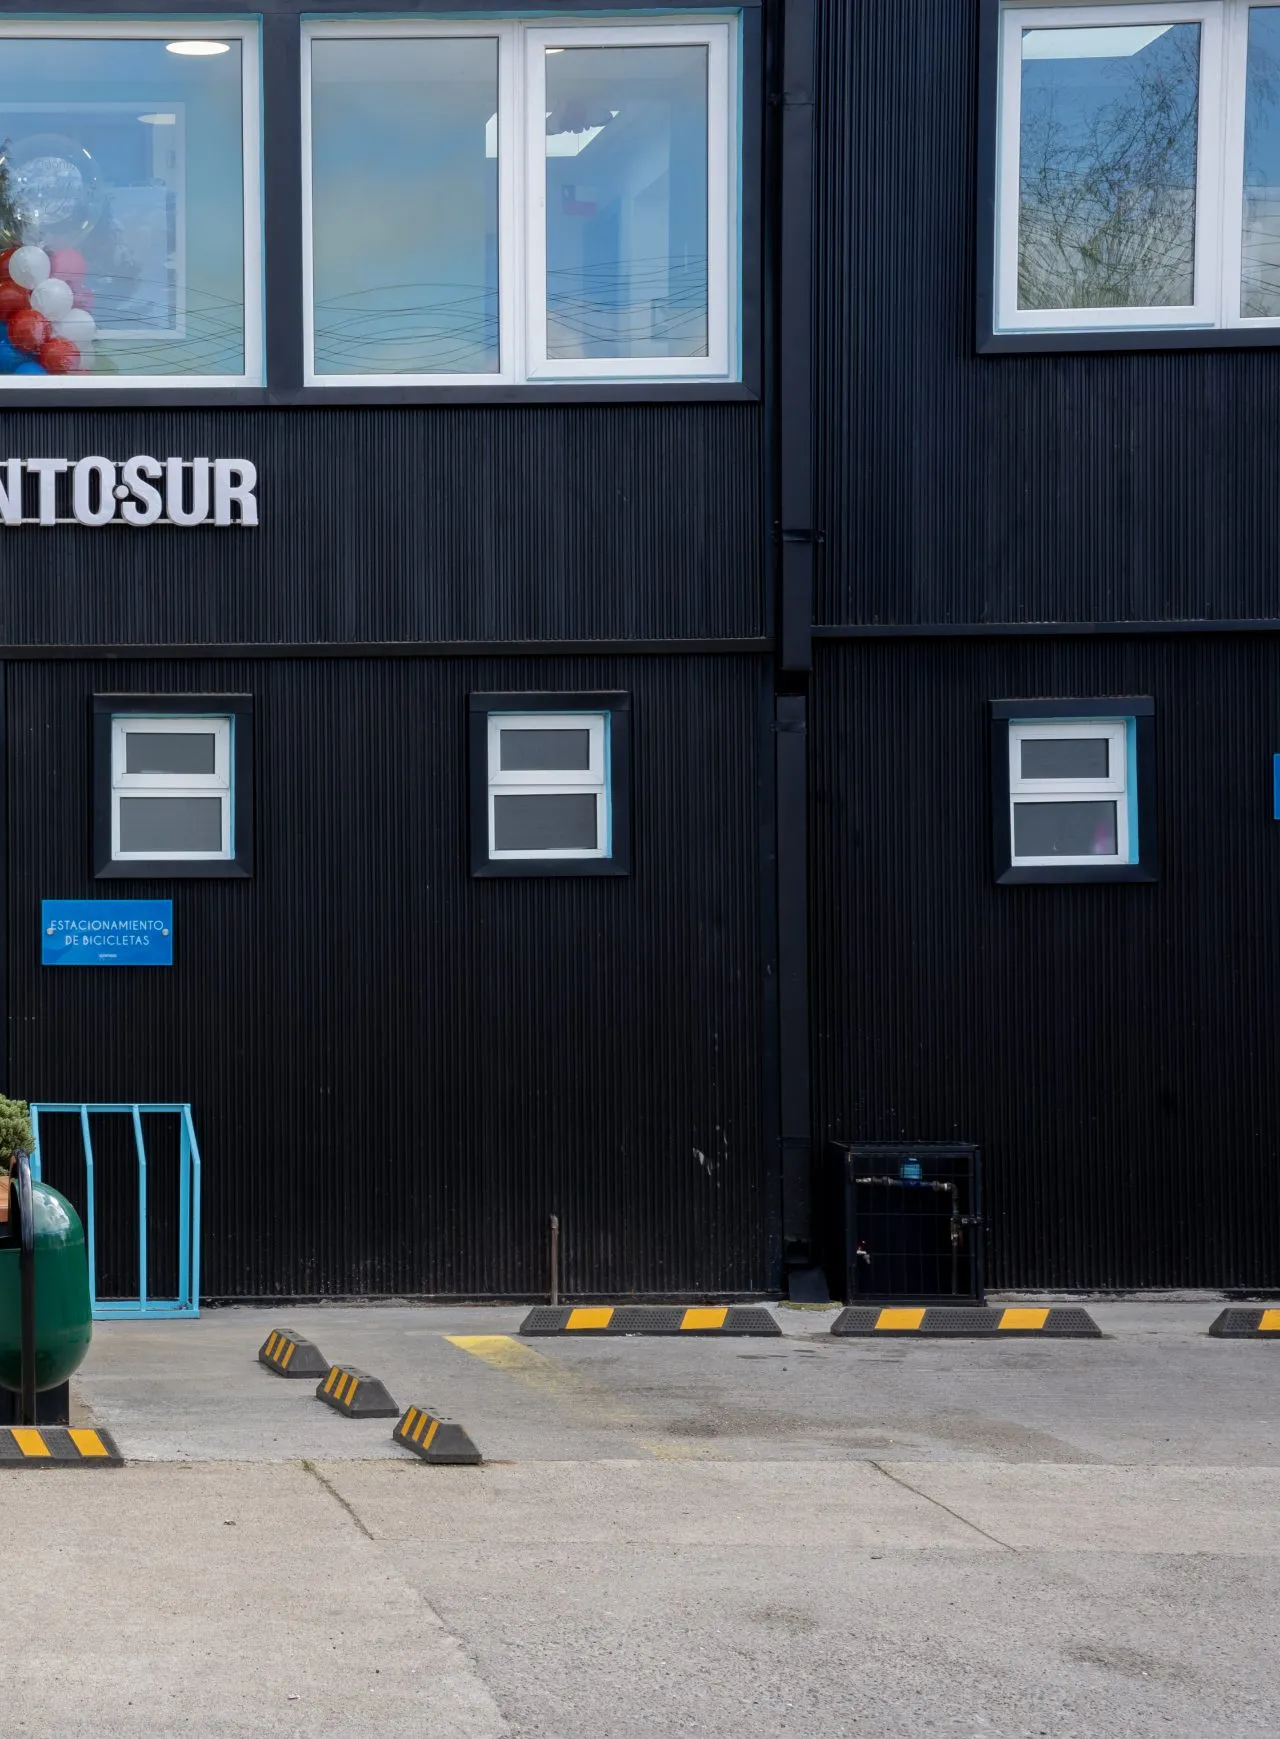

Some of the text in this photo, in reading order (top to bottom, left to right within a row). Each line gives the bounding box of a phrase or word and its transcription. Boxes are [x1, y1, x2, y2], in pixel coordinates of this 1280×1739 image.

[50, 920, 164, 931] ESTACIONAMIENTO
[65, 935, 150, 946] DE BICICLETAS
